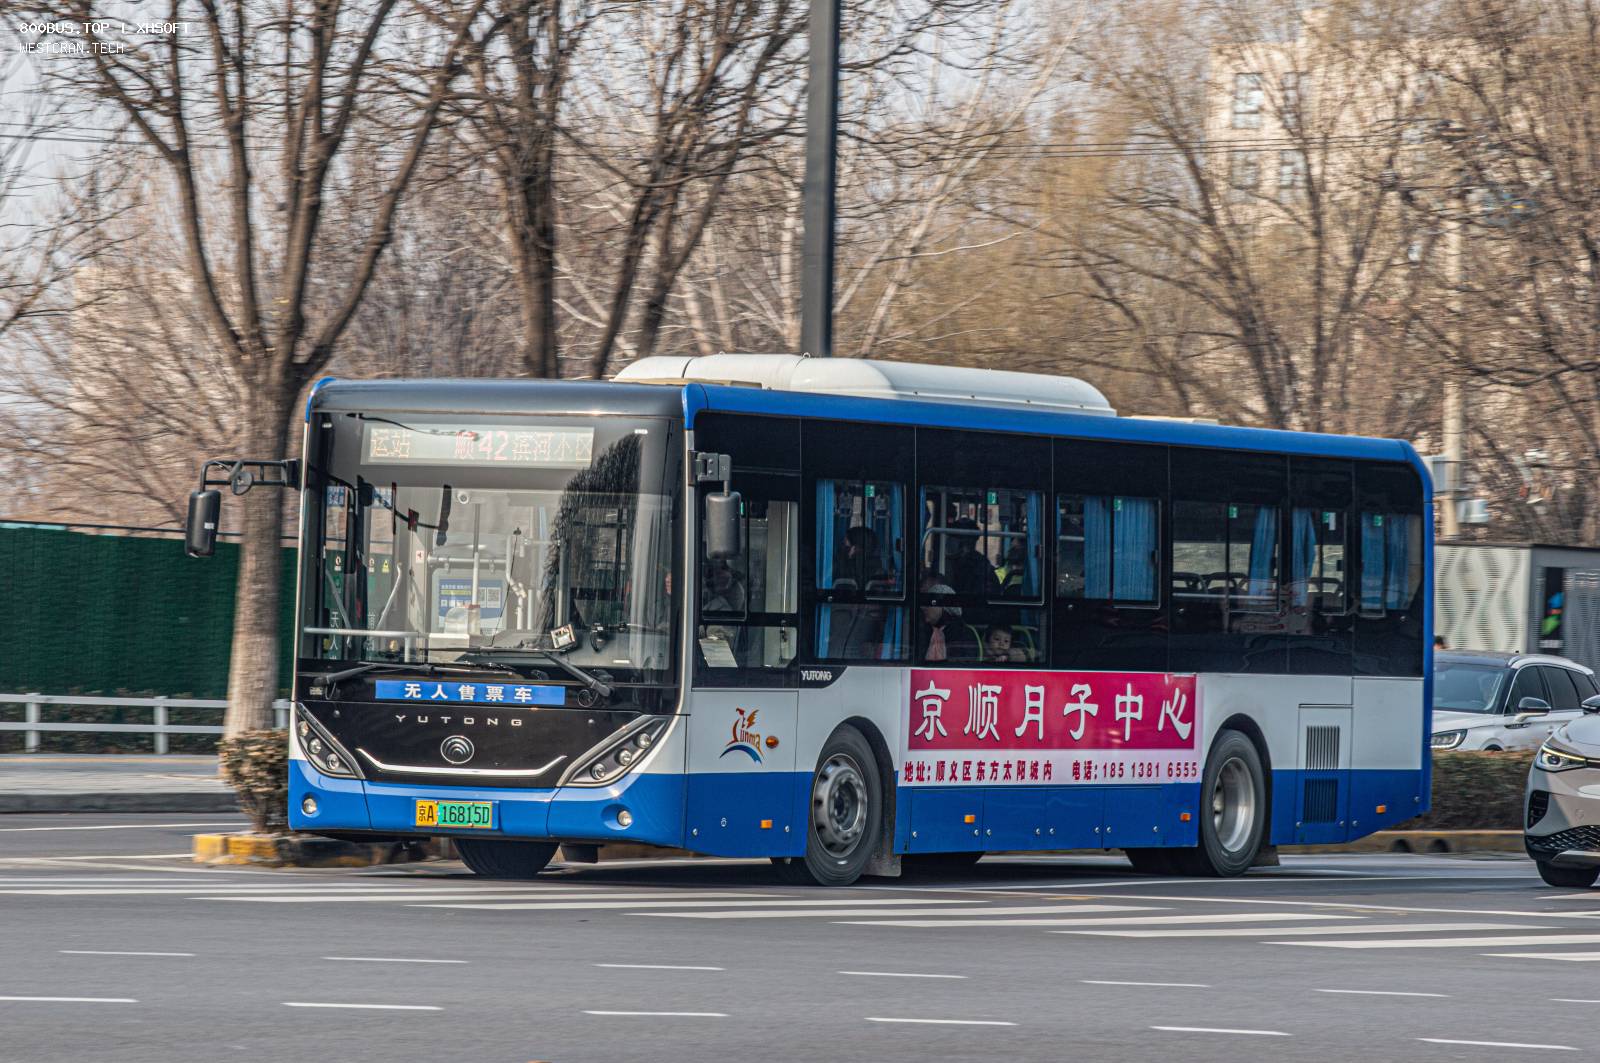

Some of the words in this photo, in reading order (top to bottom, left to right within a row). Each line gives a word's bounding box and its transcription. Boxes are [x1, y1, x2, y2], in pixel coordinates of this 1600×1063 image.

[800, 669, 833, 682] YUTONG
[404, 683, 532, 703] 无人售票车
[913, 679, 1192, 742] 京顺月子中心
[395, 715, 523, 726] YUTONG
